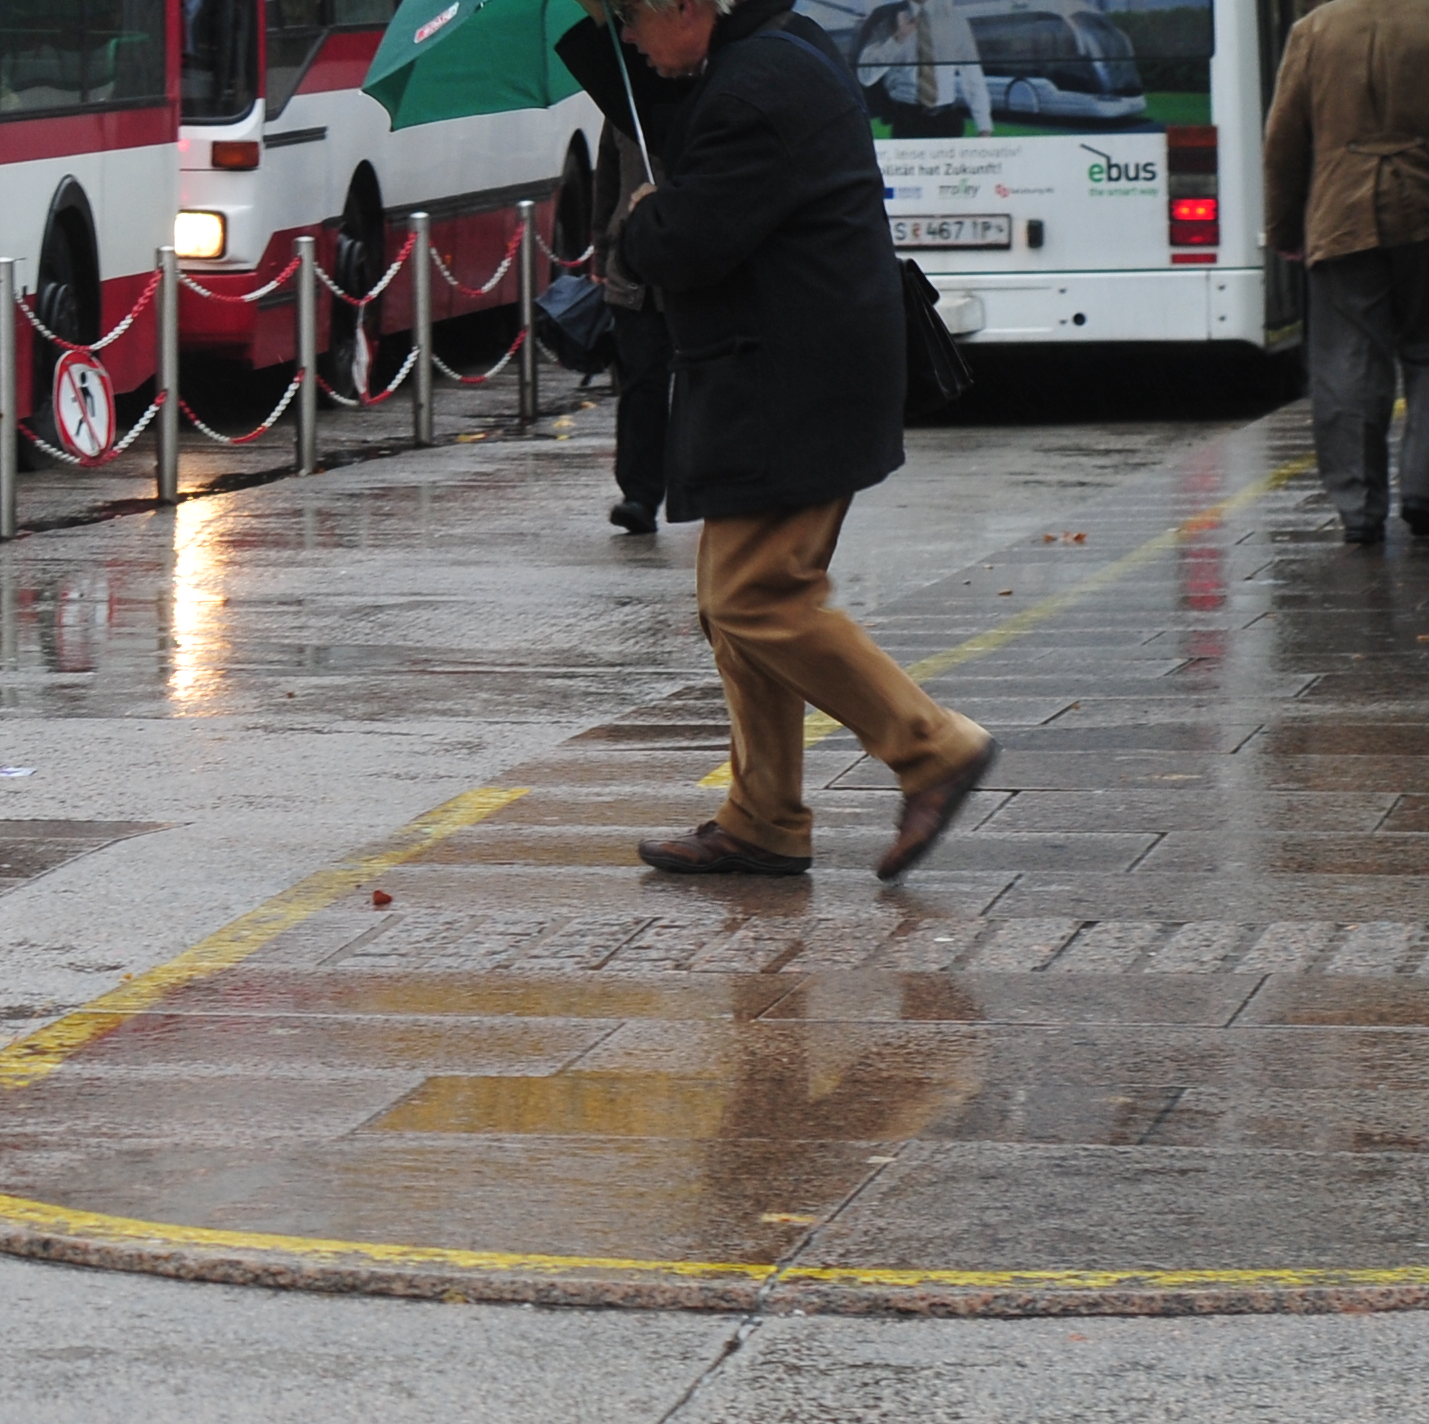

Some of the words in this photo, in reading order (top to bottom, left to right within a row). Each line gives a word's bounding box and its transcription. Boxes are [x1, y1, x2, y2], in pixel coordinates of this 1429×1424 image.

[1084, 148, 1158, 184] ebus
[894, 221, 908, 241] S
[926, 220, 964, 241] 467
